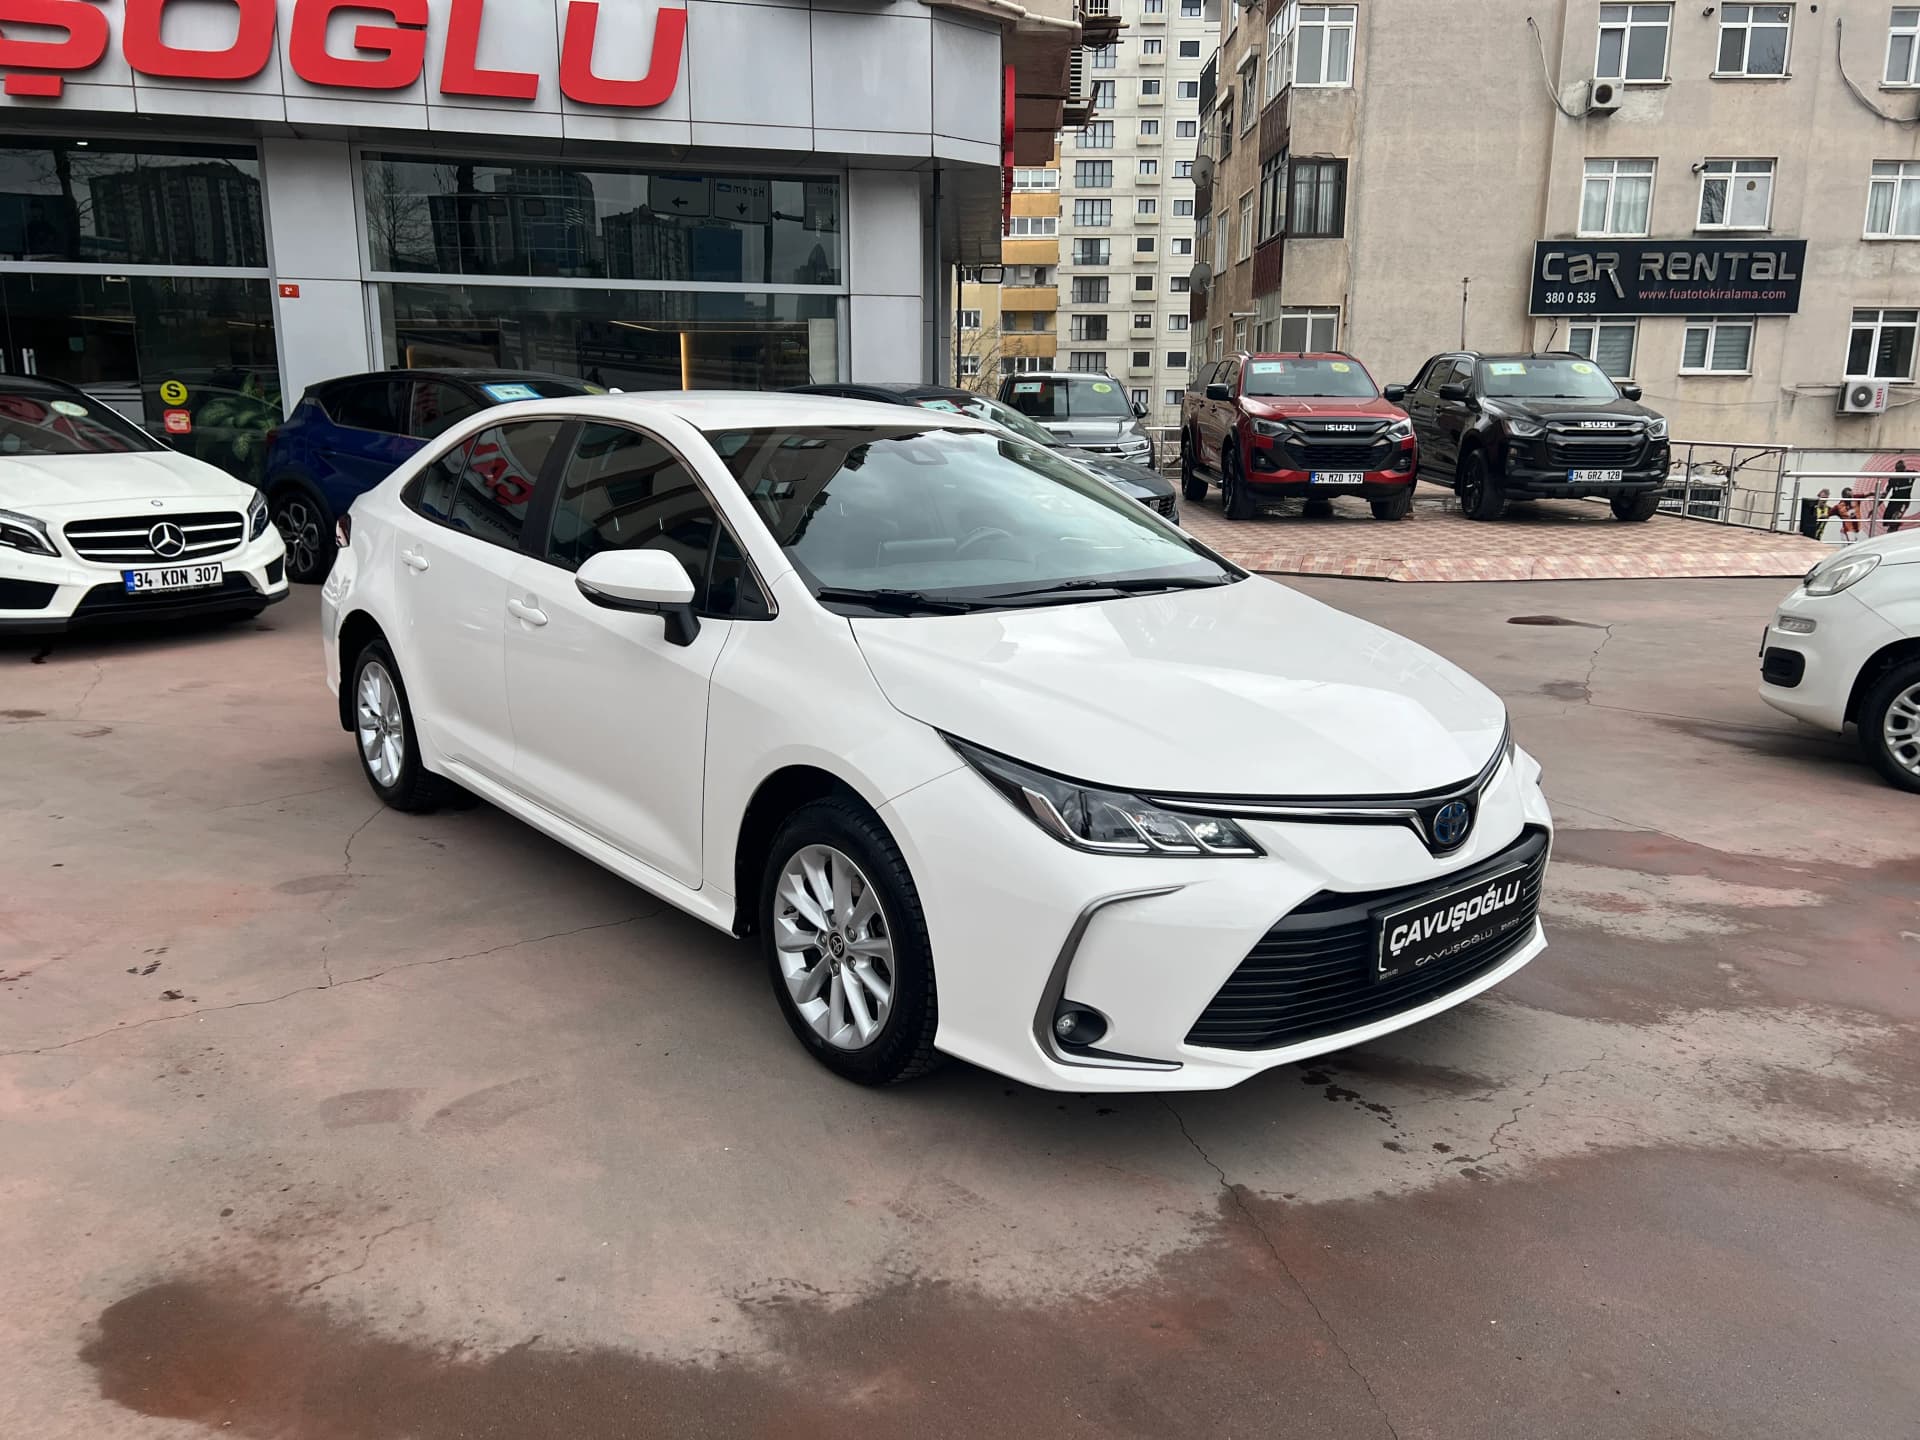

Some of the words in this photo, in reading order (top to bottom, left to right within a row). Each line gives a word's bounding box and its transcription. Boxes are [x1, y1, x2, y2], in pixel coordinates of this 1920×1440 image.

[1545, 292, 1565, 304] 380
[1567, 293, 1574, 304] 0
[1576, 292, 1596, 304] 535
[1638, 289, 1786, 300] www.fuatotokiralama.com
[166, 383, 180, 397] S
[1315, 473, 1325, 482] 34
[1348, 473, 1362, 482] 179
[1574, 471, 1583, 480] 34
[1587, 471, 1602, 480] GRZ
[1607, 471, 1620, 480] 128
[134, 572, 153, 588] 34
[161, 569, 188, 586] KDN
[194, 566, 219, 583] 307
[1390, 880, 1521, 957] ÇAVUŞOĞLU
